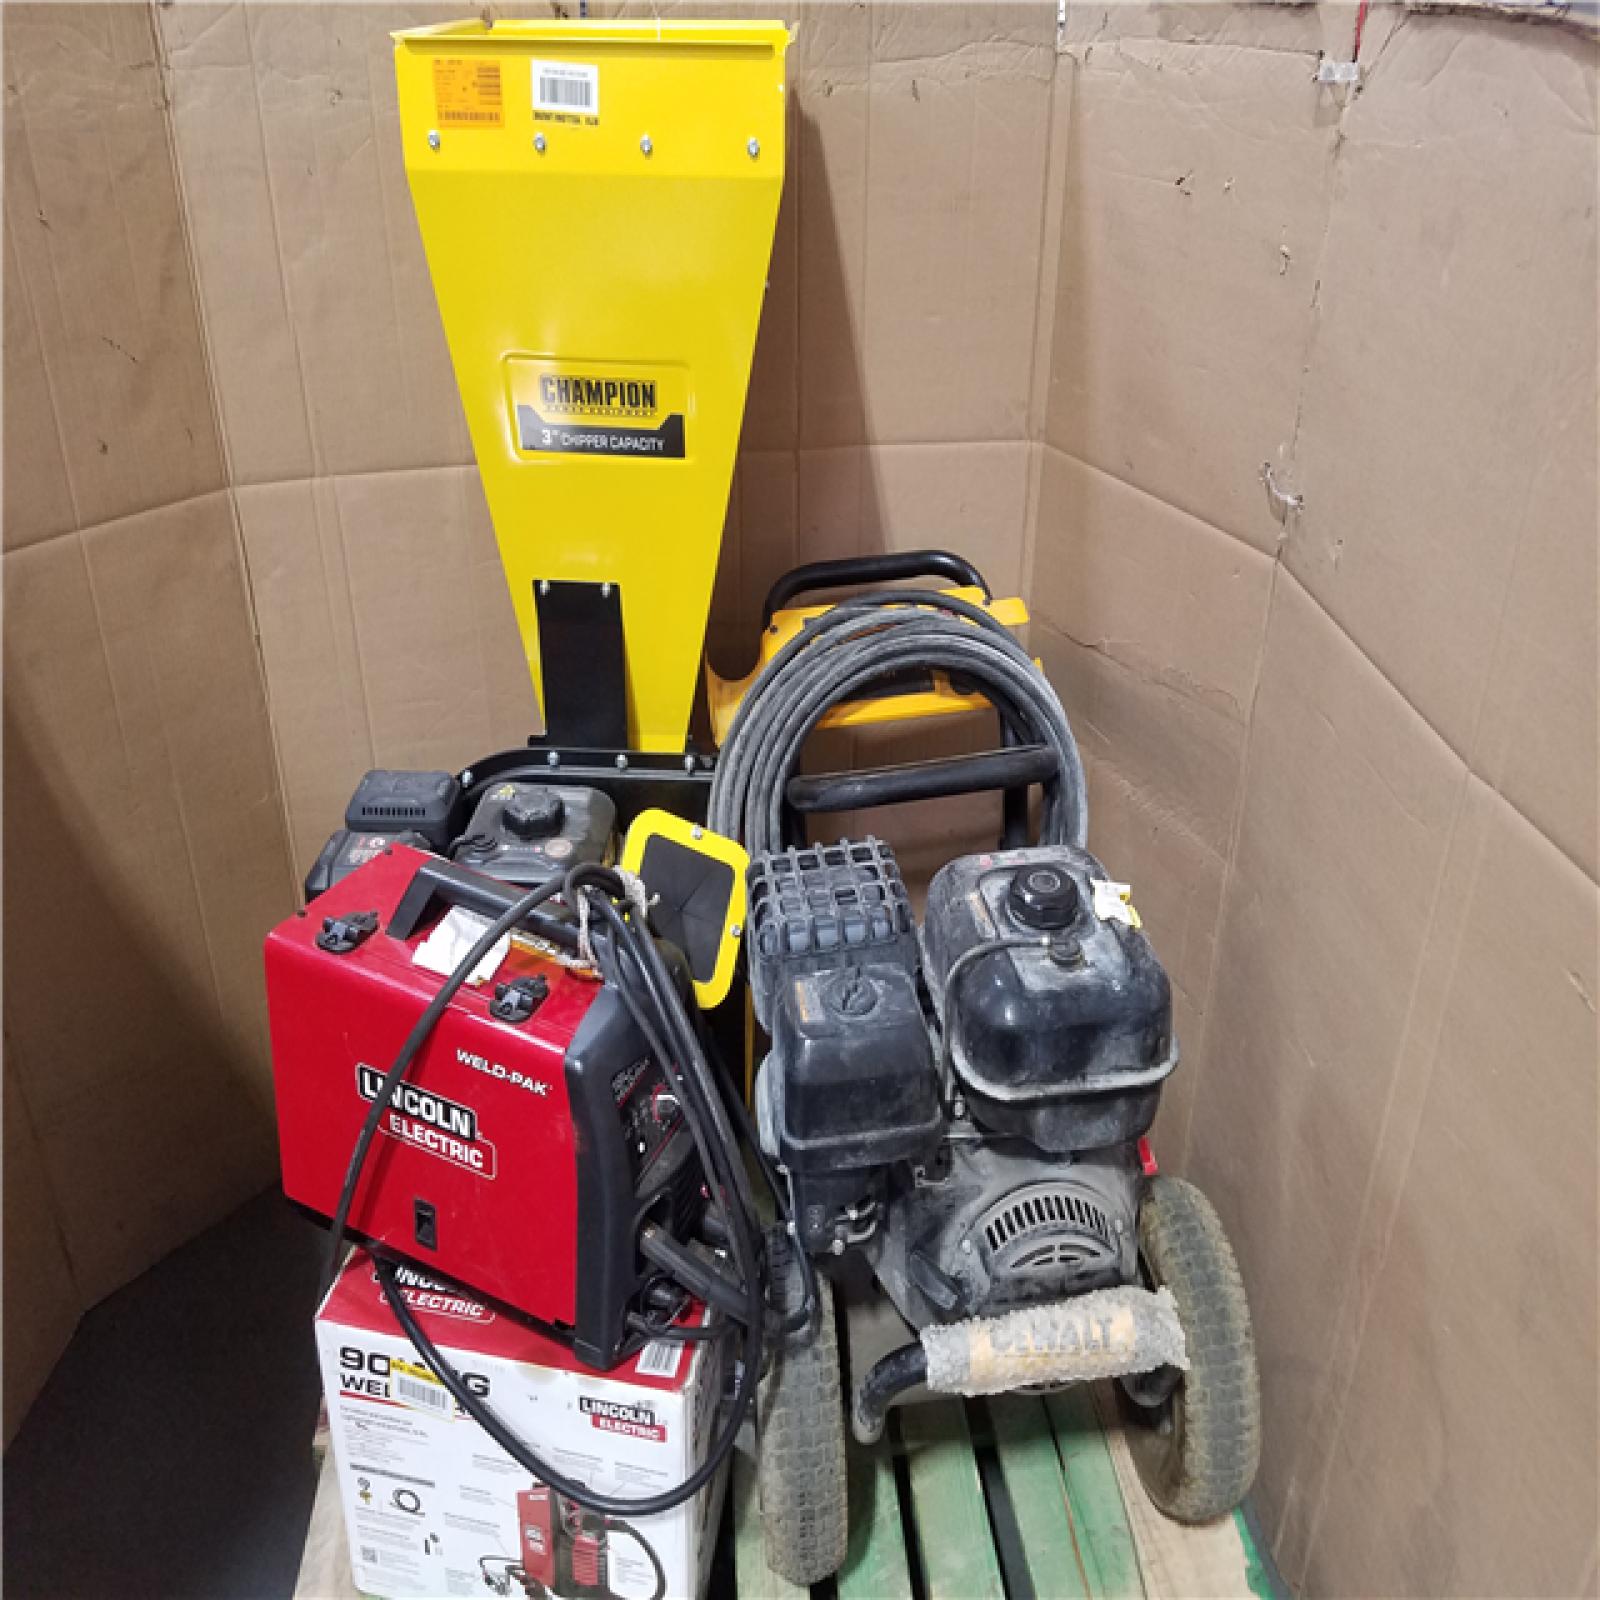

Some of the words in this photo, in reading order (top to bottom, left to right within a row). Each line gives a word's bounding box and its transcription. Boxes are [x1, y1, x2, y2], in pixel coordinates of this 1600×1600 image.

[541, 376, 656, 408] CHAMPION
[562, 433, 609, 448] CHIPPER
[610, 436, 665, 451] CAPACITY
[456, 1049, 547, 1096] WELD-PAK
[389, 1113, 484, 1169] ELECTRIC
[582, 1398, 653, 1425] LINCOLN
